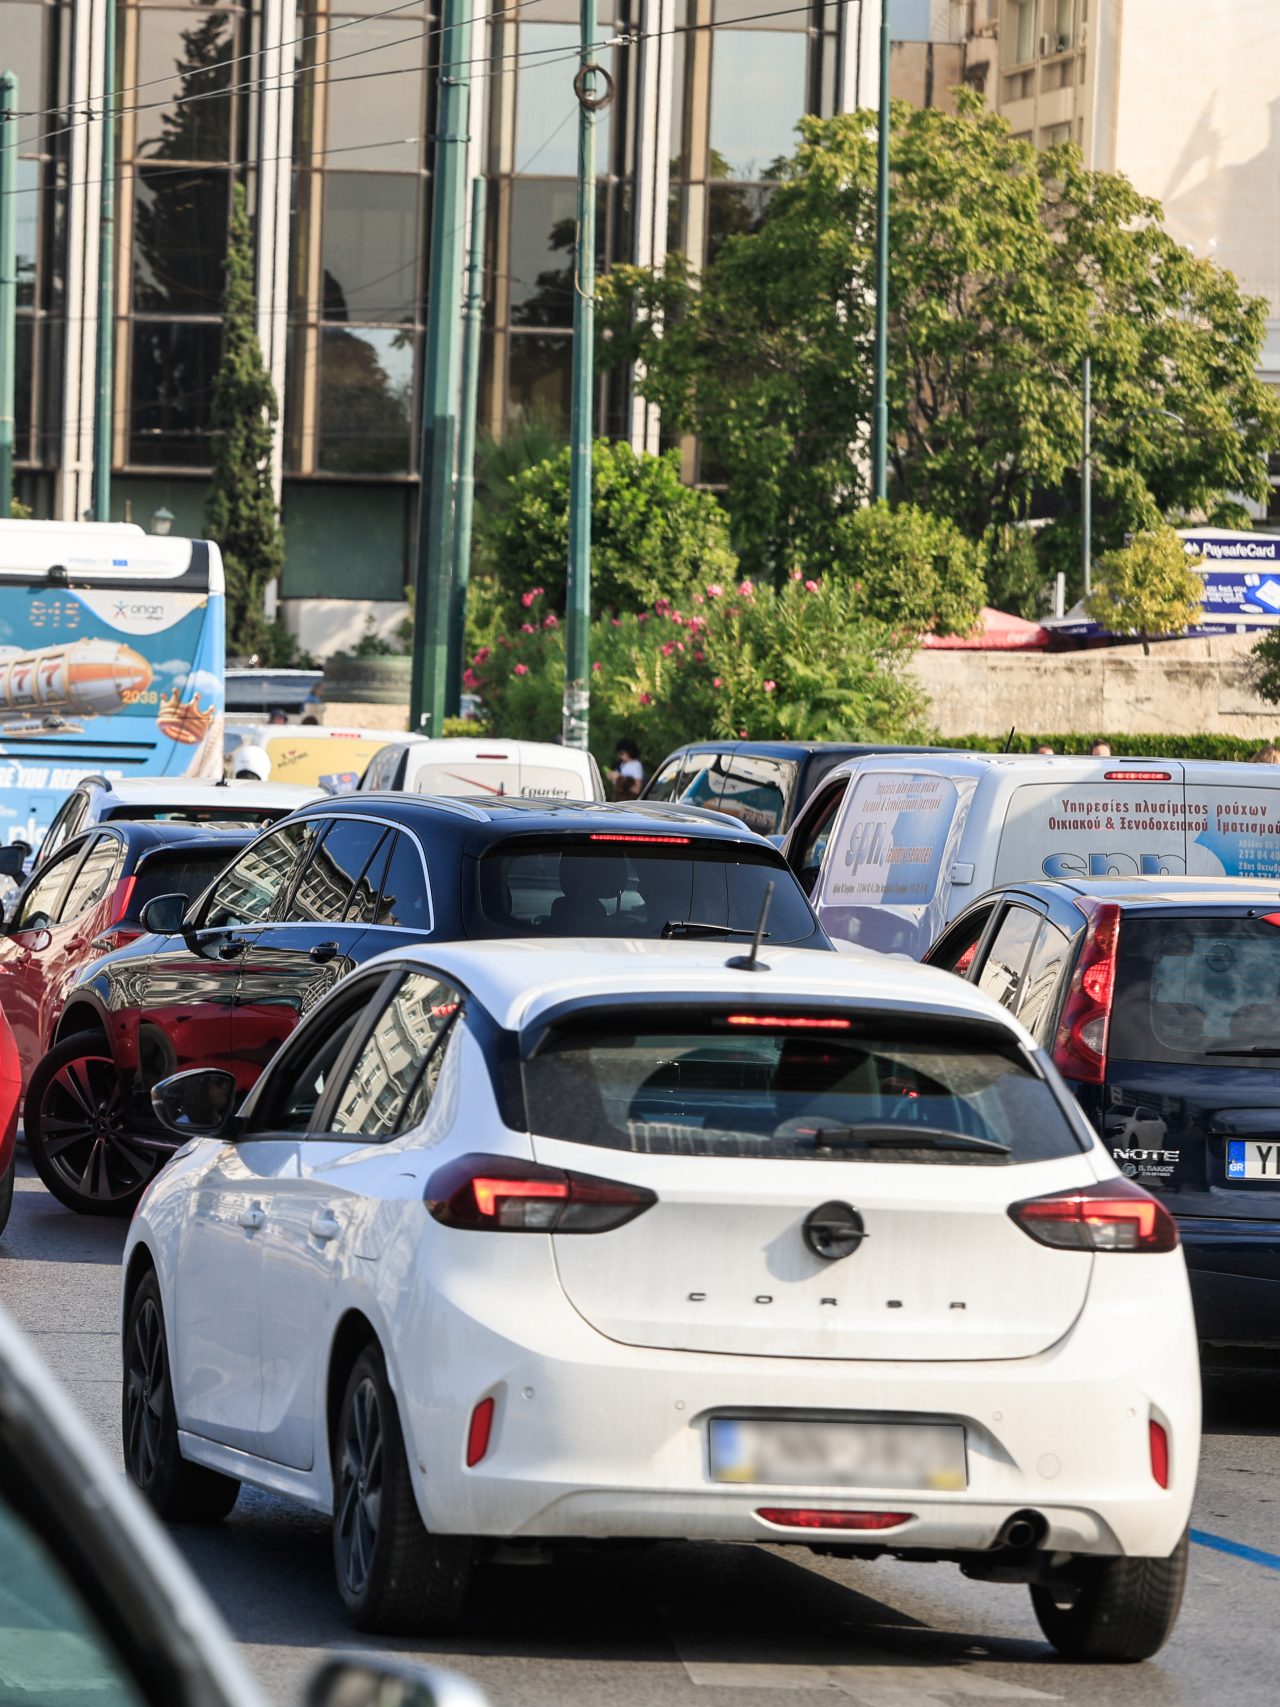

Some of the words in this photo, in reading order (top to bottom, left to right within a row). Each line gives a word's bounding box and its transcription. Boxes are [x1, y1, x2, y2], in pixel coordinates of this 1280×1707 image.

[1203, 542, 1276, 558] PaysafeCard
[122, 690, 158, 704] 2038
[17, 767, 49, 788] YOU
[1062, 799, 1129, 815] Υπηρεσίες
[1135, 800, 1208, 816] πλυσίματος
[1216, 801, 1267, 816] ρούχων
[1049, 816, 1100, 830] Οικιακού
[1105, 817, 1115, 830] &
[1120, 817, 1208, 831] Ξενοδοχειακού
[1113, 1148, 1180, 1162] NOTE
[1256, 1145, 1280, 1176] Y
[1229, 1163, 1244, 1172] GR
[687, 1292, 966, 1310] CORSA
